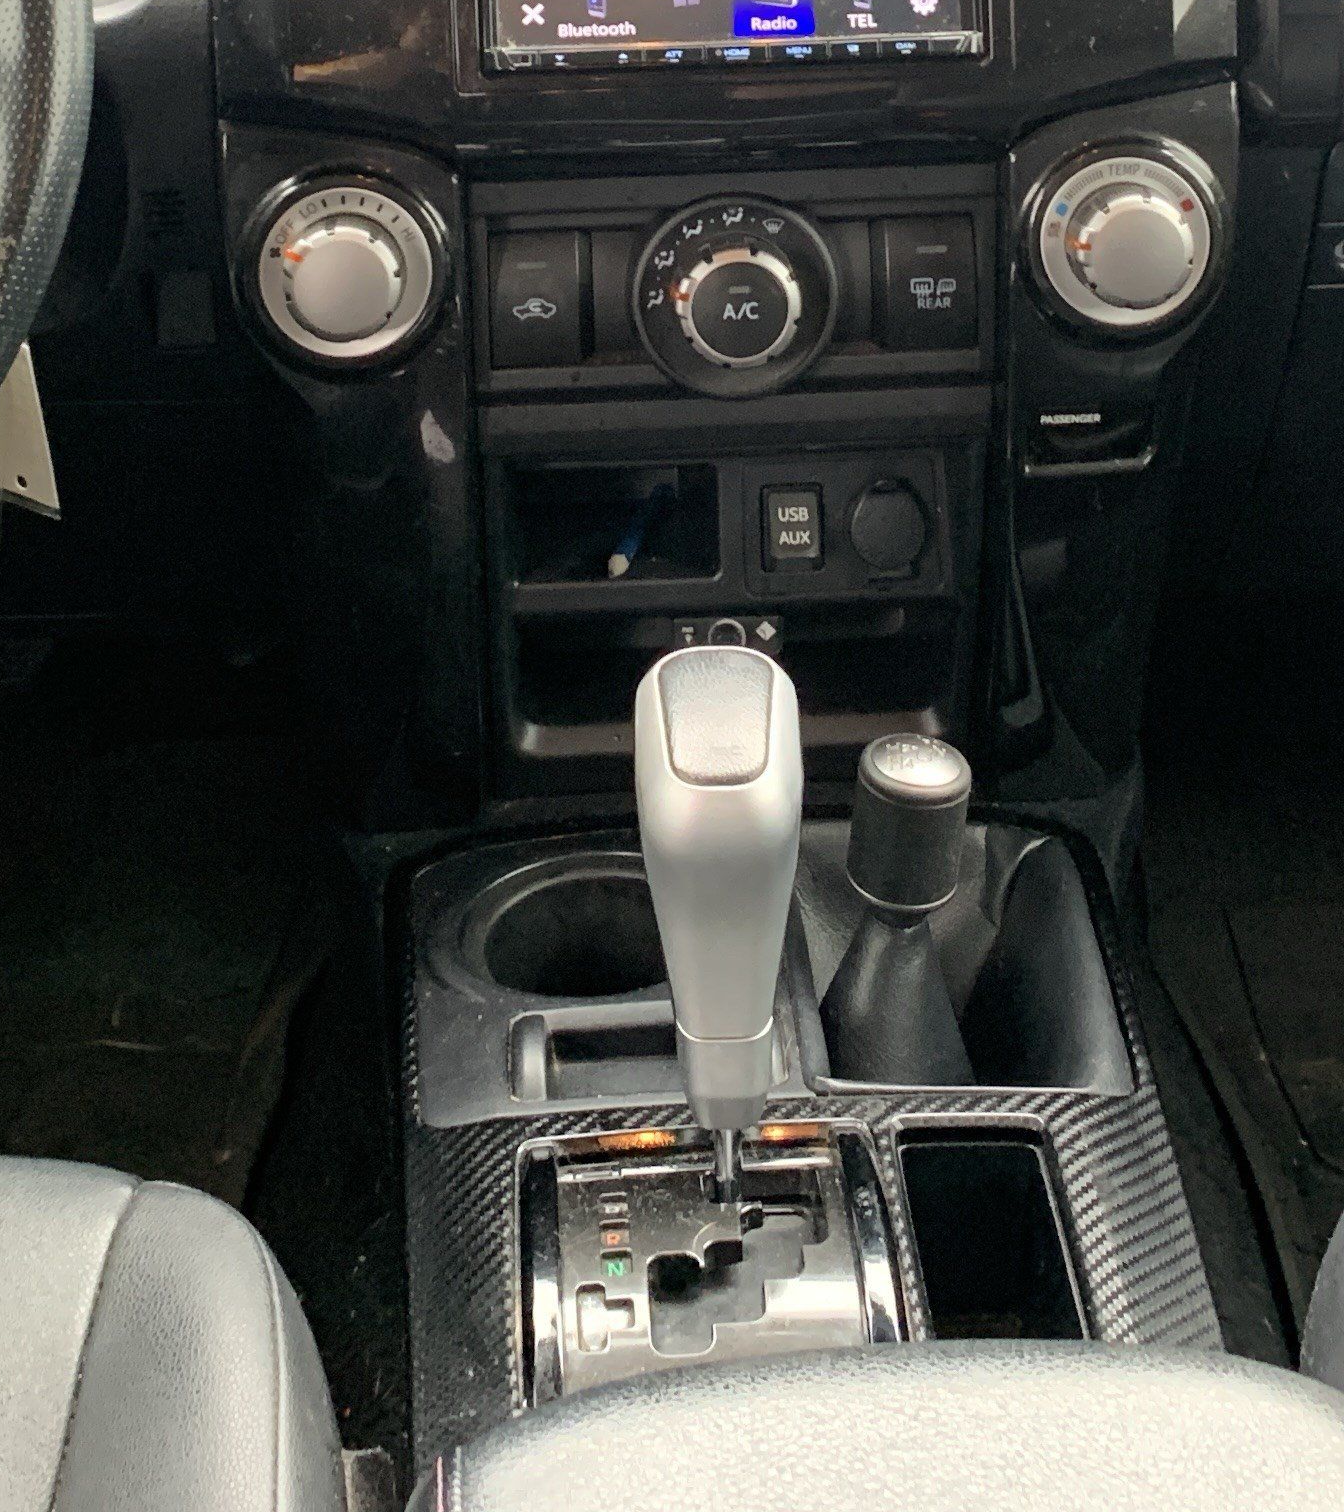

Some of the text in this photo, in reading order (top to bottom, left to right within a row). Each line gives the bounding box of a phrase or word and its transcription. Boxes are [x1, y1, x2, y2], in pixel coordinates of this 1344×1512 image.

[750, 16, 798, 31] Radio
[846, 13, 878, 29] TEL
[557, 21, 637, 38] Bluetooth
[1108, 162, 1141, 176] TEMP
[298, 201, 318, 219] LO
[275, 217, 296, 245] OFF
[916, 295, 952, 309] REAR
[722, 301, 760, 321] A/C
[1040, 413, 1102, 426] PASSENGER
[777, 507, 809, 523] USB
[778, 531, 811, 546] AUX
[607, 1261, 625, 1277] N
